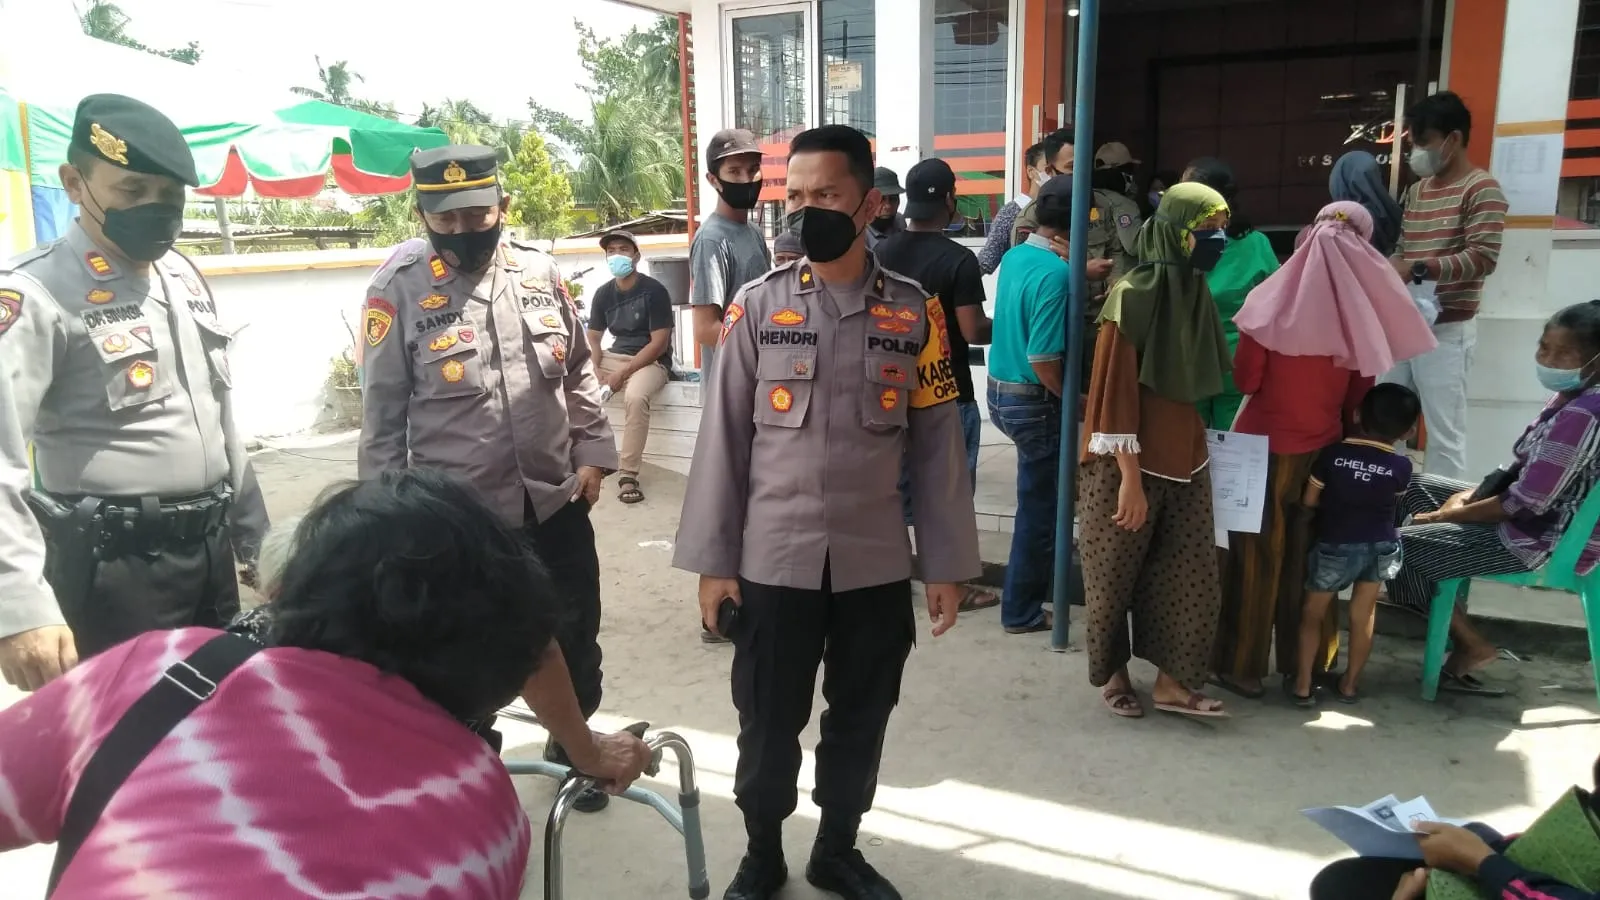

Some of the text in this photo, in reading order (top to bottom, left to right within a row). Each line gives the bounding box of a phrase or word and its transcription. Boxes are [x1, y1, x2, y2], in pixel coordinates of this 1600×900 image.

[415, 311, 464, 333] SANDY
[759, 330, 818, 347] HENDRI
[868, 336, 920, 357] POLRI
[1334, 457, 1393, 478] CHELSEA
[1353, 471, 1372, 482] FC
